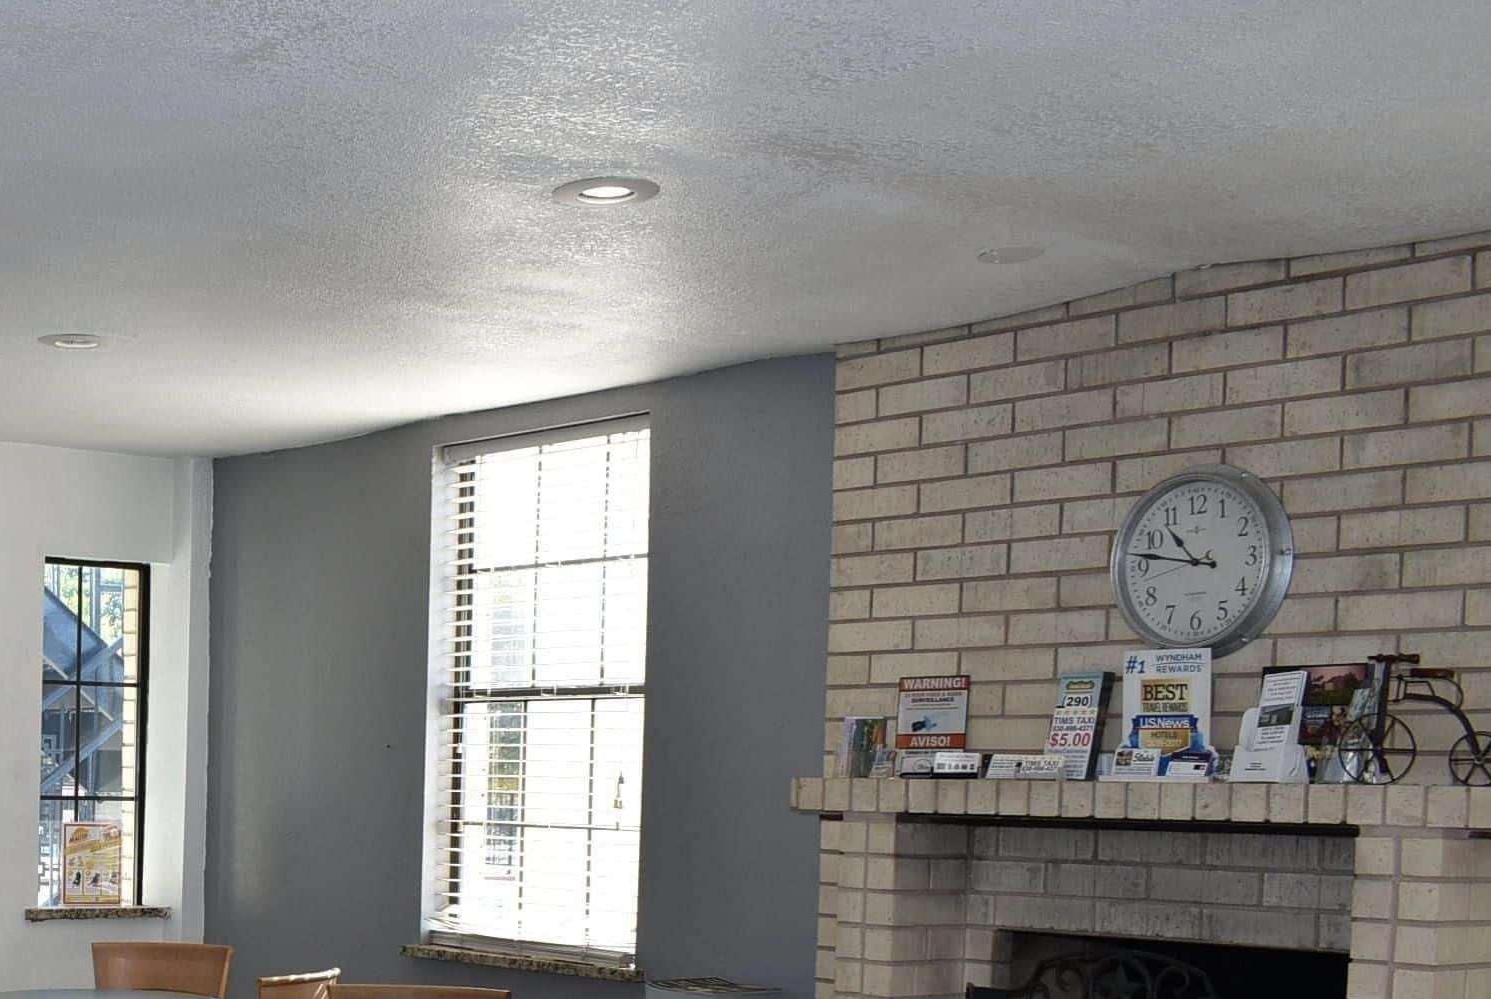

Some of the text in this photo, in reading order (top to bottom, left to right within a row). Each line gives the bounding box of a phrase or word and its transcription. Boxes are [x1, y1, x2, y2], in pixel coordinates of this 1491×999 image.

[1189, 494, 1207, 515] 12
[1218, 498, 1227, 518] 1
[1163, 506, 1179, 526] 11
[1237, 516, 1249, 537] 2
[1146, 529, 1163, 550] 10
[1245, 545, 1257, 566] 3
[1137, 558, 1149, 578] 9
[1145, 586, 1157, 606] 8
[1234, 577, 1248, 596] 4
[1165, 604, 1176, 625] 7
[1189, 609, 1202, 630] 6
[1216, 600, 1229, 621] 5
[1126, 655, 1146, 674] #1
[1156, 653, 1202, 662] WYNDHAM
[1156, 664, 1202, 673] REWARDS
[904, 677, 967, 689] WARNING!
[1143, 683, 1188, 701] BEST
[1062, 695, 1093, 707] (290)
[910, 736, 951, 747] AVISO!
[1049, 732, 1091, 747] $5.00
